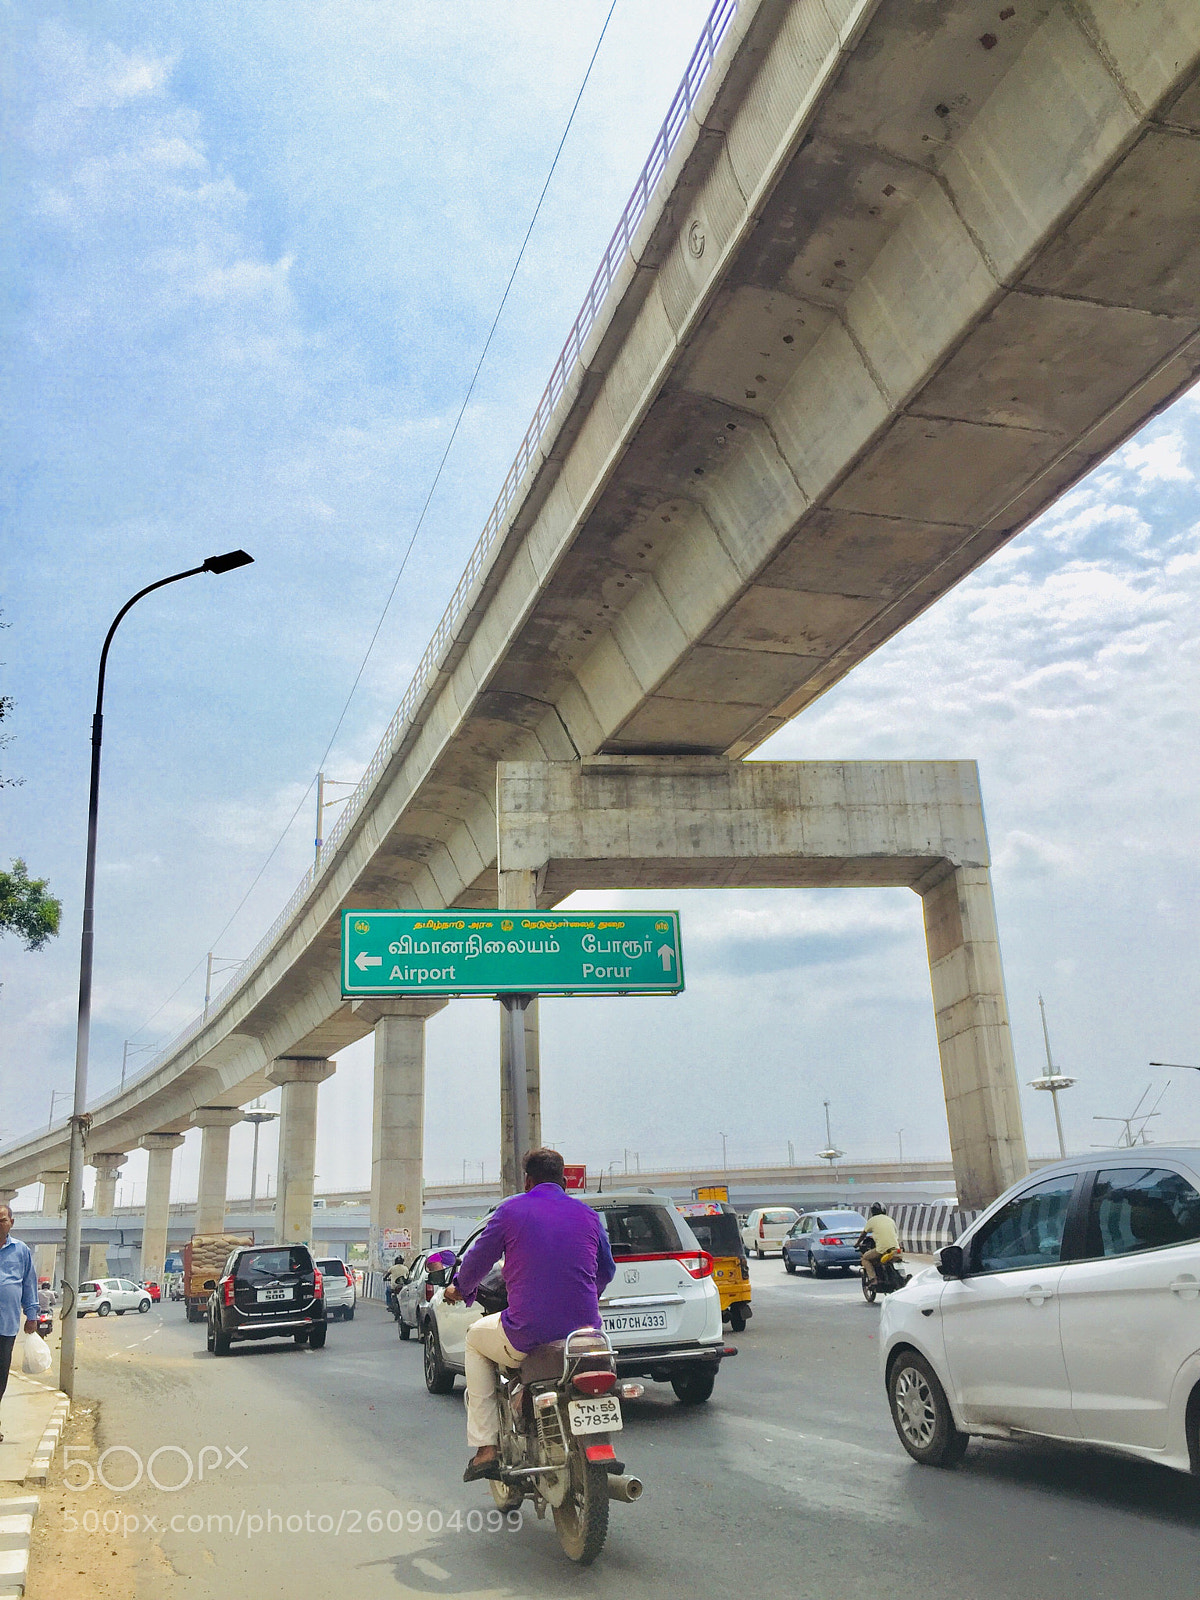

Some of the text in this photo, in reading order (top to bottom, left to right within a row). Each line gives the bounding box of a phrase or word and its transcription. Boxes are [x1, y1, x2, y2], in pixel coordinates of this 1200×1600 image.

[388, 934, 561, 961] விமானநிலையம்
[581, 933, 653, 959] போரூர்
[388, 964, 456, 984] Airport
[582, 963, 632, 979] Porur
